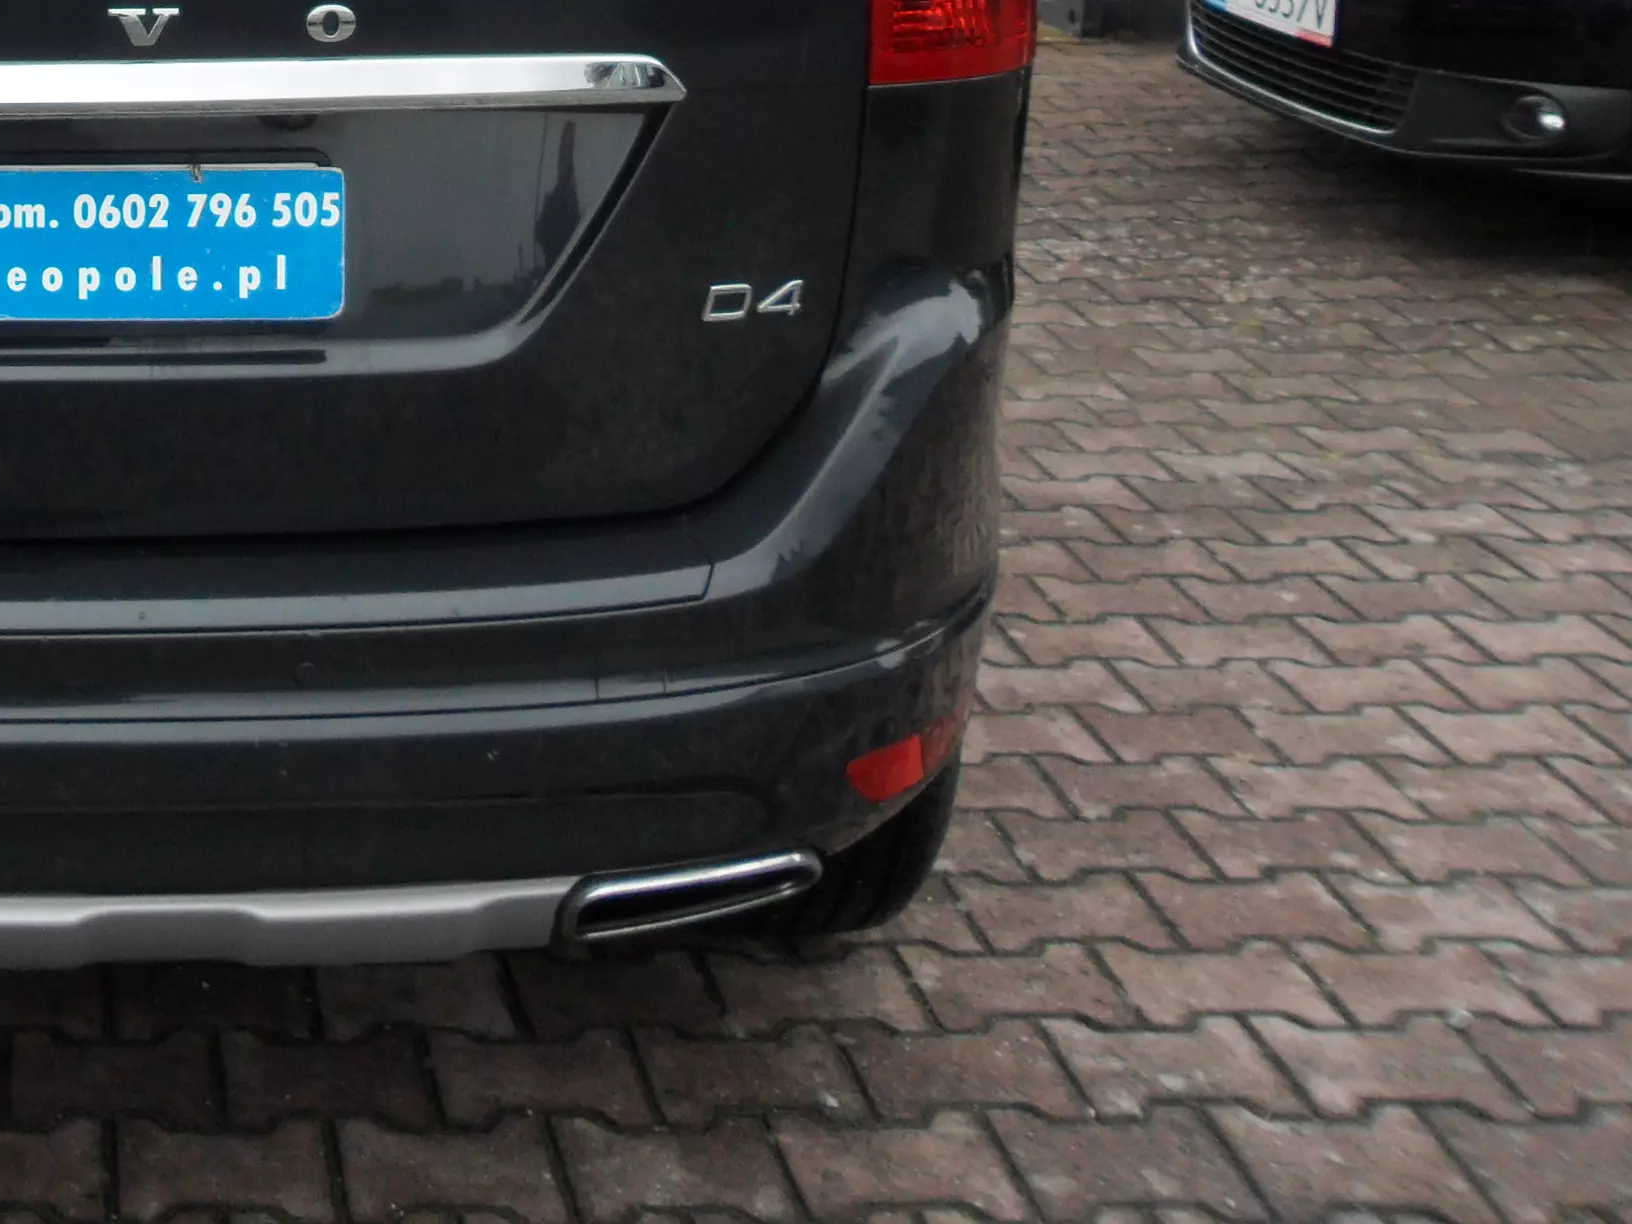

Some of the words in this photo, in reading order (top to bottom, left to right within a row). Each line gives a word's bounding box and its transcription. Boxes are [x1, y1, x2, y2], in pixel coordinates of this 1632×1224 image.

[73, 193, 169, 229] 0602
[186, 193, 257, 228] 796
[271, 191, 340, 227] 505
[701, 279, 803, 322] D4
